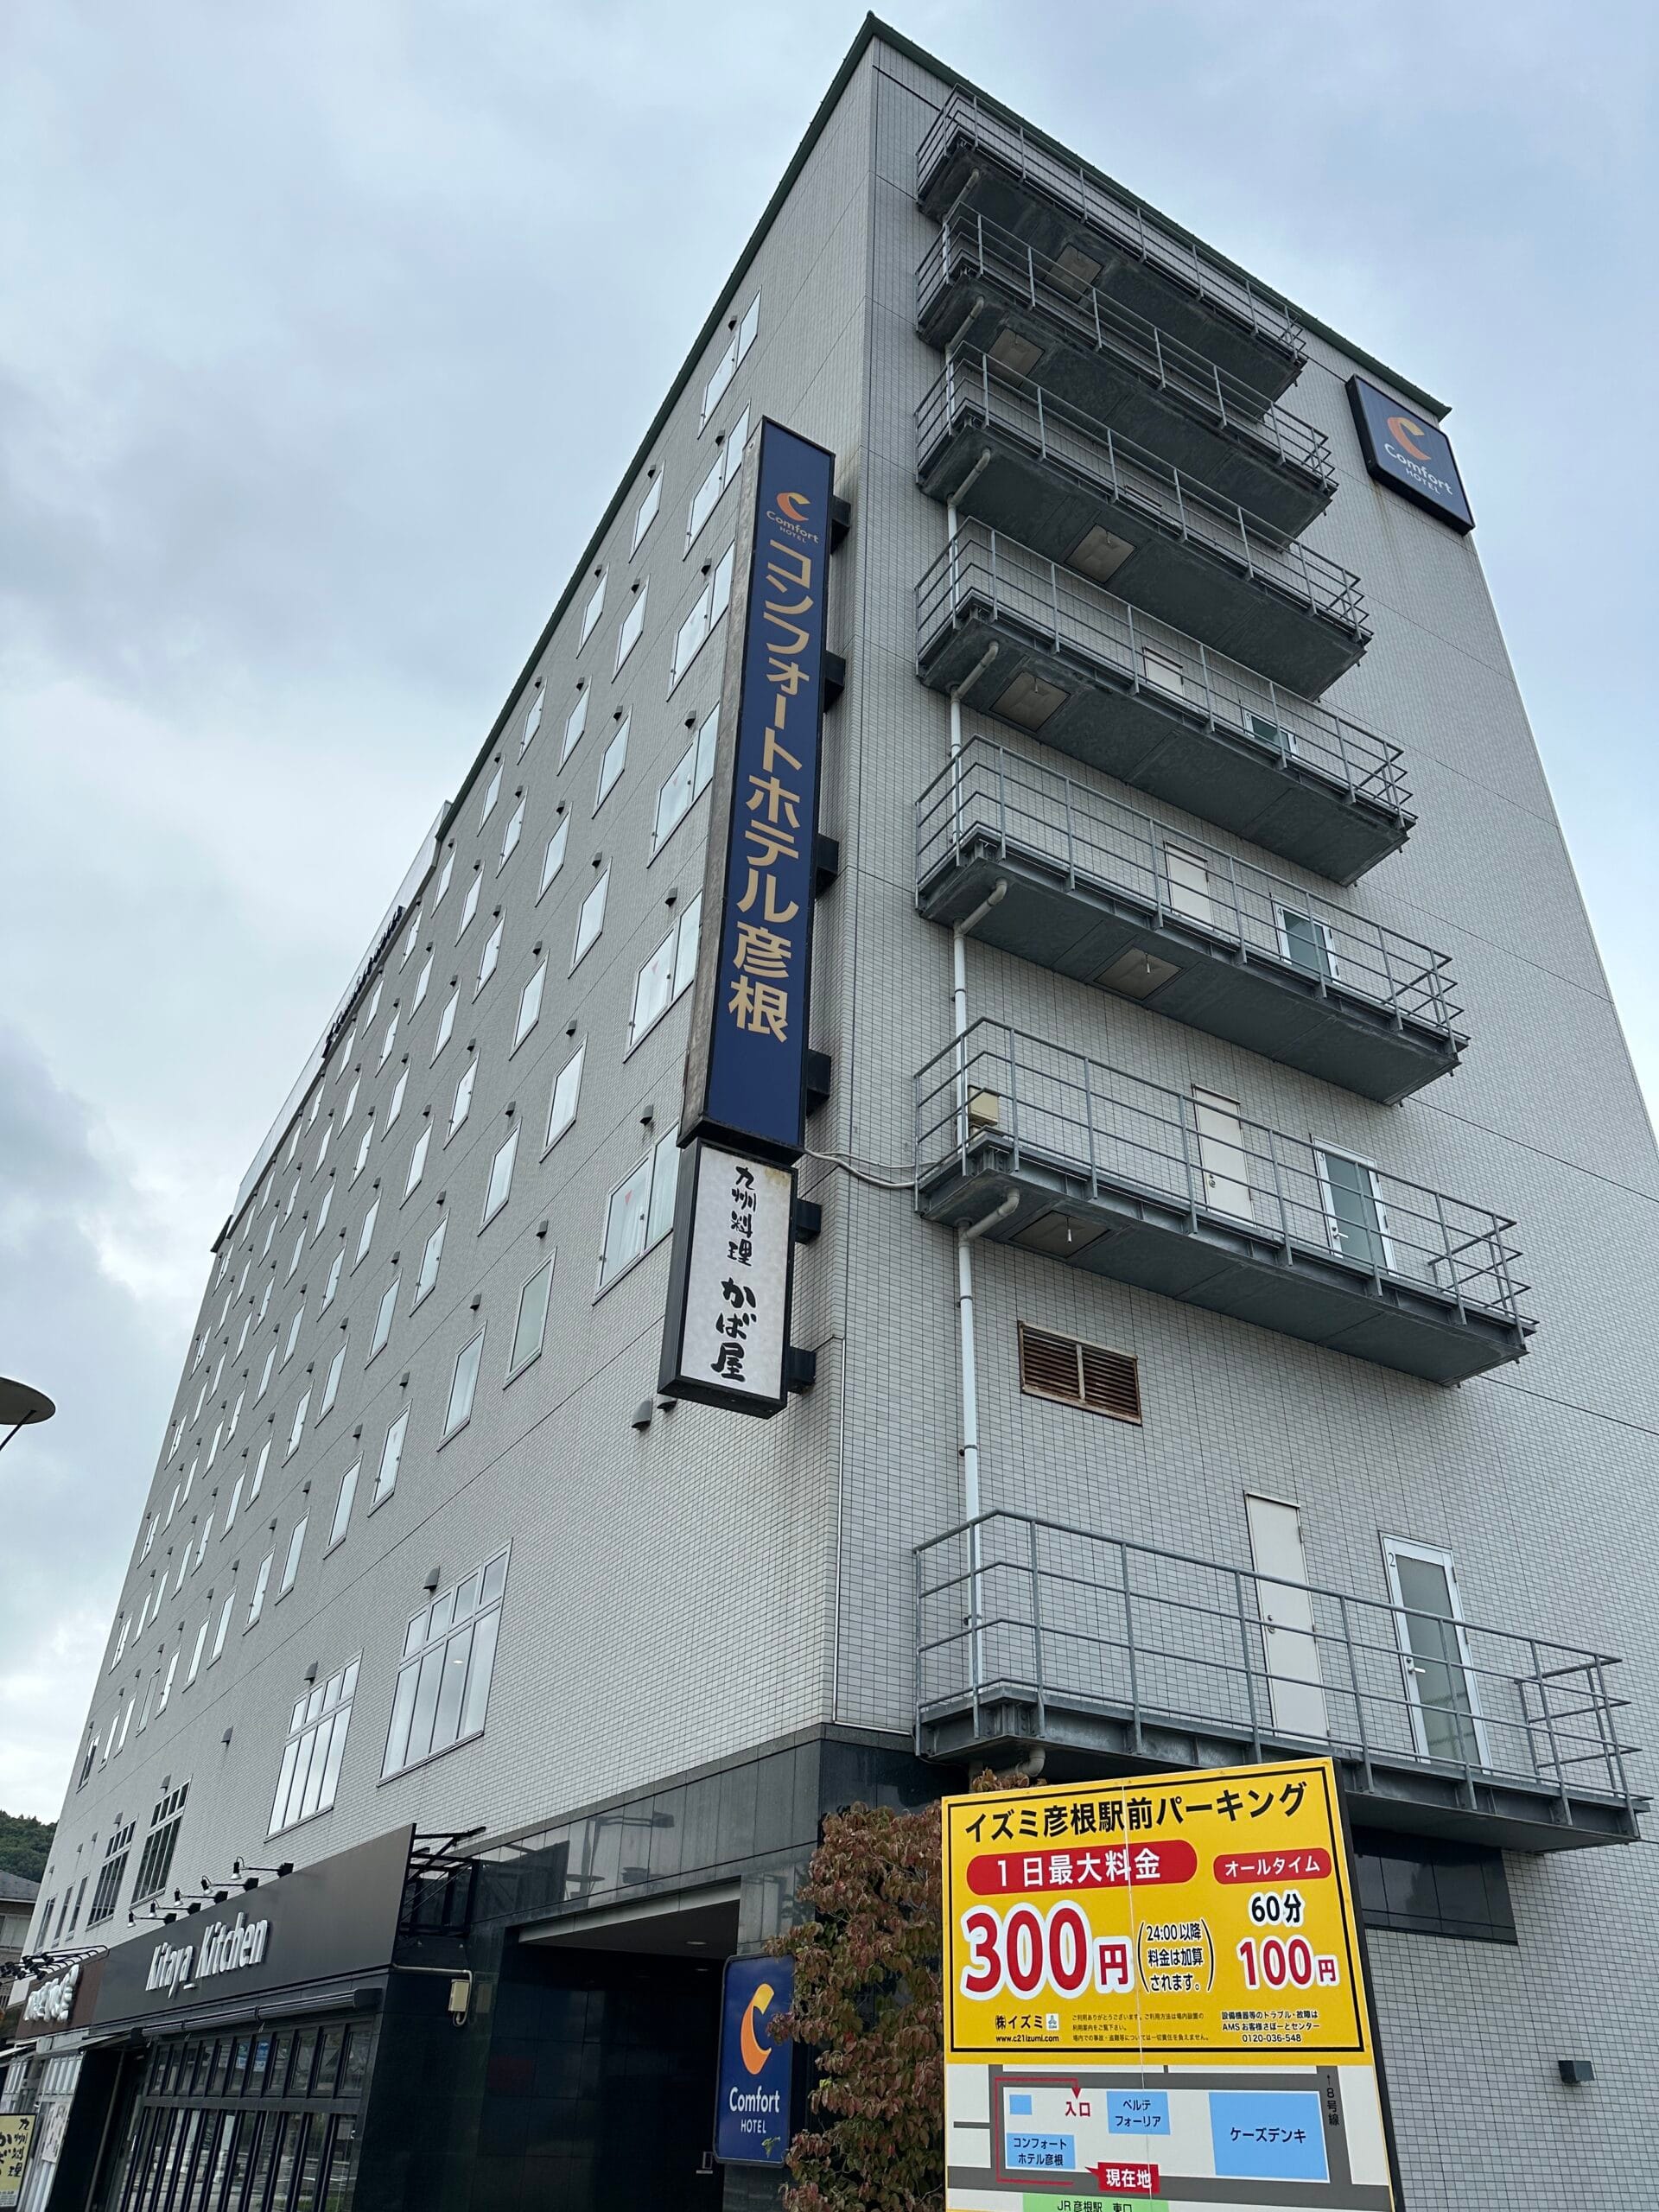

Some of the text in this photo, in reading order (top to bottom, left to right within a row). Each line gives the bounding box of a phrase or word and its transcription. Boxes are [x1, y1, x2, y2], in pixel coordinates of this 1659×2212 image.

[1384, 443, 1453, 495] Comfort
[1406, 469, 1440, 495] HOTEL
[766, 511, 819, 543] Comfort
[779, 527, 806, 543] HOTEL
[728, 538, 814, 1043] コンフォートホテル彦根
[710, 1166, 756, 1382] 九州料理 かば屋
[1388, 1553, 1395, 1567] 2
[965, 1781, 1307, 1842] イズミ彦根駅前パーキング
[997, 1847, 1161, 1887] 1日最大料金
[1224, 1855, 1321, 1878] オールタイム
[1251, 1893, 1301, 1923] 60分
[966, 1907, 1129, 1993] 300円
[1147, 1948, 1204, 1967] 料金は加算
[1239, 1938, 1337, 1986] 100円
[1242, 2033, 1301, 2042] 0120-036-548
[729, 2085, 780, 2113] Comfort
[1065, 2101, 1091, 2117] 入口
[1326, 2088, 1339, 2126] 8号線
[741, 2119, 766, 2133] HOTEL
[1115, 2115, 1161, 2127] フォーリア
[1014, 2138, 1067, 2151] コンフォート
[1230, 2126, 1306, 2143] ケーズデンキ
[1018, 2152, 1064, 2166] ホテル彦根
[1106, 2168, 1152, 2188] 現在地
